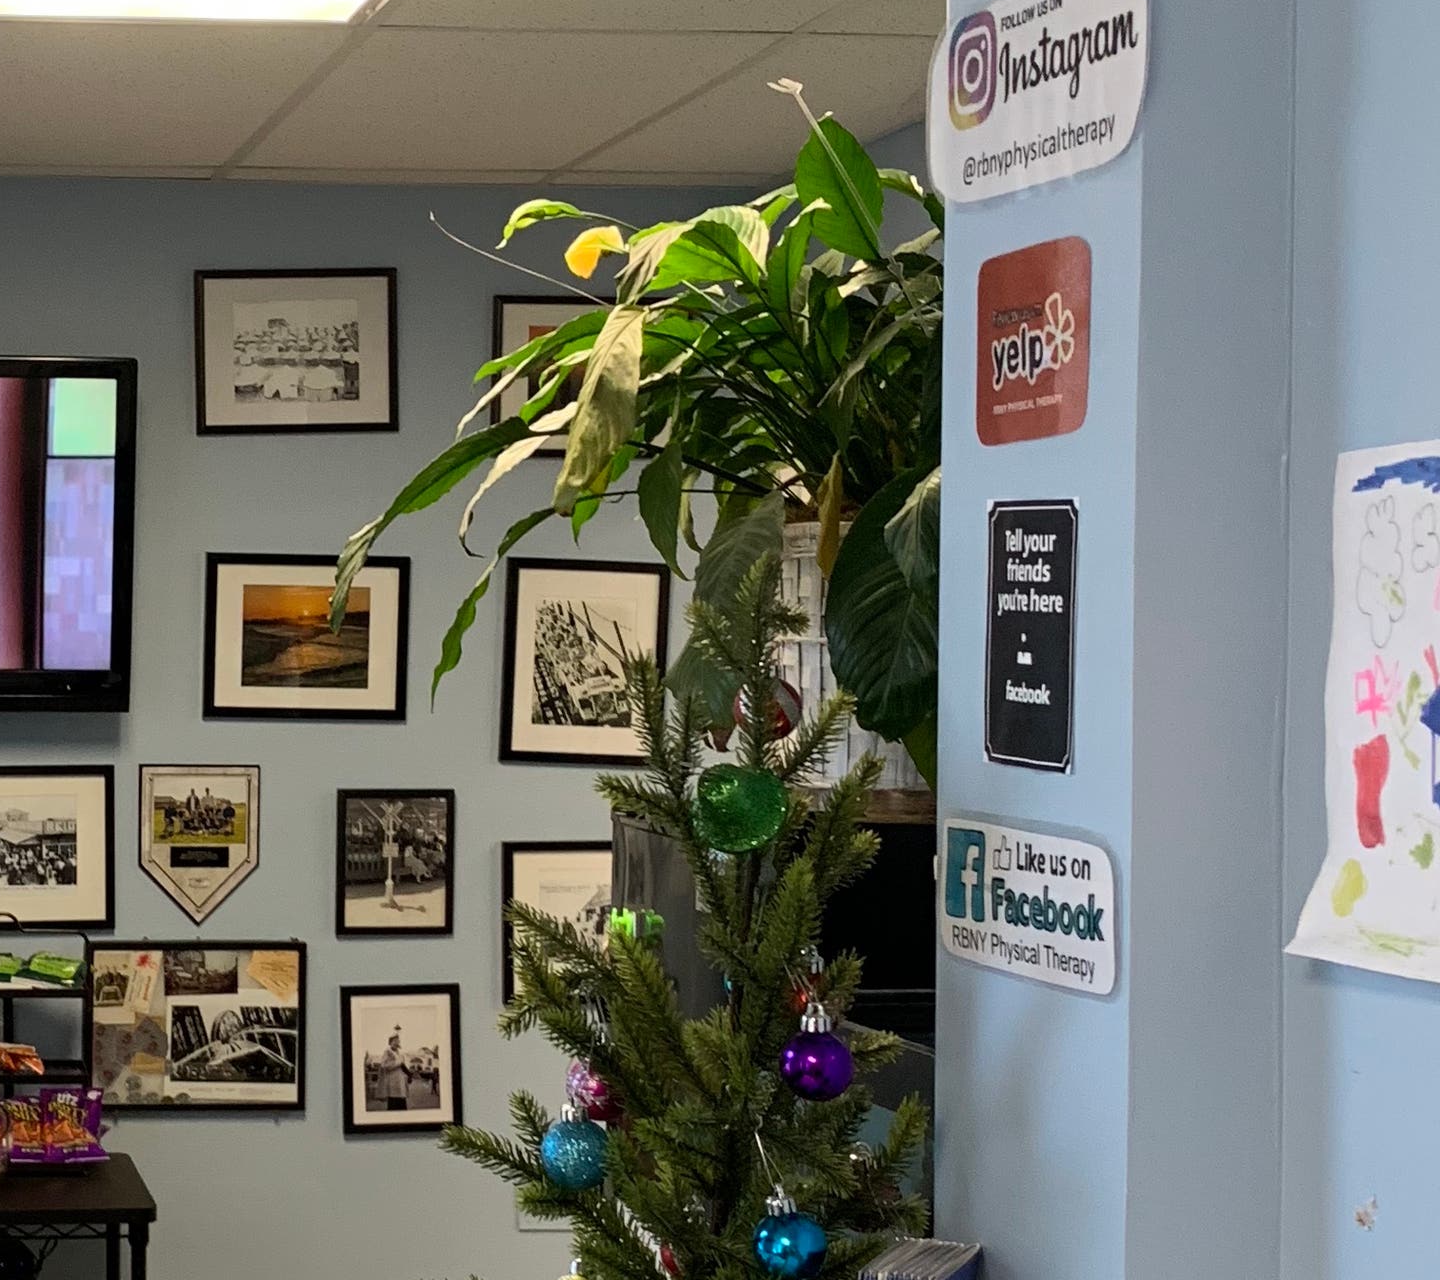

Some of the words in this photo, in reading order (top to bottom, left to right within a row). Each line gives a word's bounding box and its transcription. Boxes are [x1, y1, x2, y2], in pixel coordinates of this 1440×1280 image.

[1000, 4, 1034, 32] FOLLOW
[1037, 0, 1048, 17] US
[999, 11, 1139, 103] Instagram
[963, 114, 1115, 186] @rbnyphysicaltherapy
[992, 323, 1044, 390] yelp
[1005, 528, 1023, 553] Tell
[1023, 533, 1057, 559] your
[1006, 558, 1052, 583] friends
[997, 588, 1028, 617] you're
[1030, 587, 1064, 614] here
[1005, 679, 1051, 706] facebook
[1016, 841, 1046, 874] Like
[1049, 854, 1067, 877] us
[1071, 858, 1091, 881] on
[991, 876, 1105, 942] Facebook
[952, 925, 988, 953] RBNY
[991, 933, 1041, 965] Physical
[1043, 944, 1096, 984] Therapy
